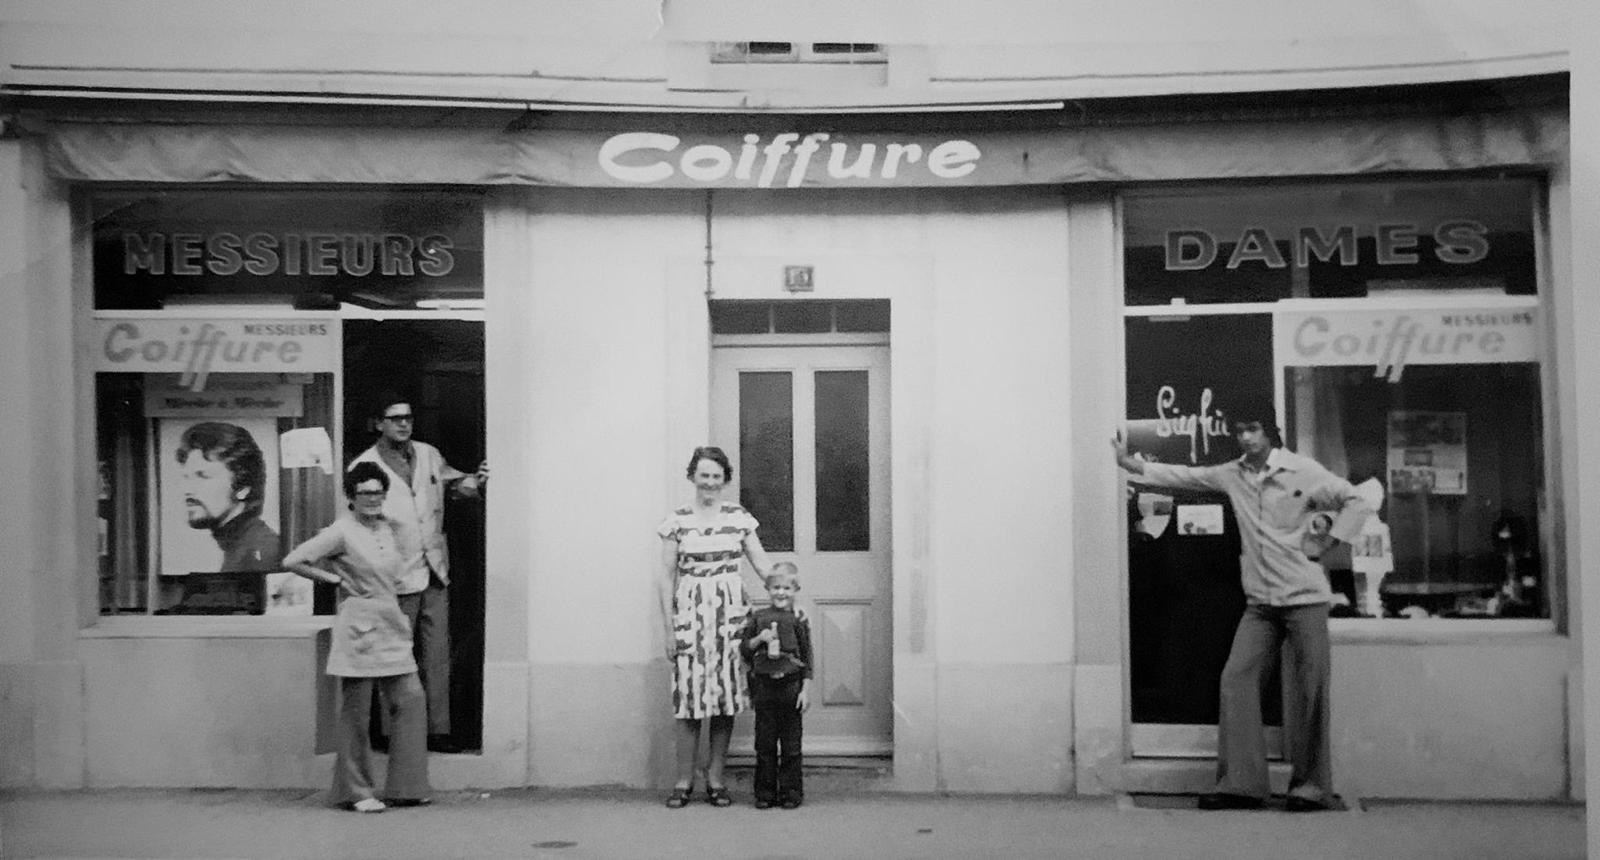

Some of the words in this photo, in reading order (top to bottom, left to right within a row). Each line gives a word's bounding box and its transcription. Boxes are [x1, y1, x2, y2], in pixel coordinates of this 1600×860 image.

[599, 132, 981, 188] Coiffure
[124, 231, 455, 277] MESSIEURS
[1165, 220, 1490, 271] DAMES
[243, 323, 328, 337] MESSIEURS
[1294, 315, 1506, 384] Coiffure
[104, 322, 304, 393] Coiffure
